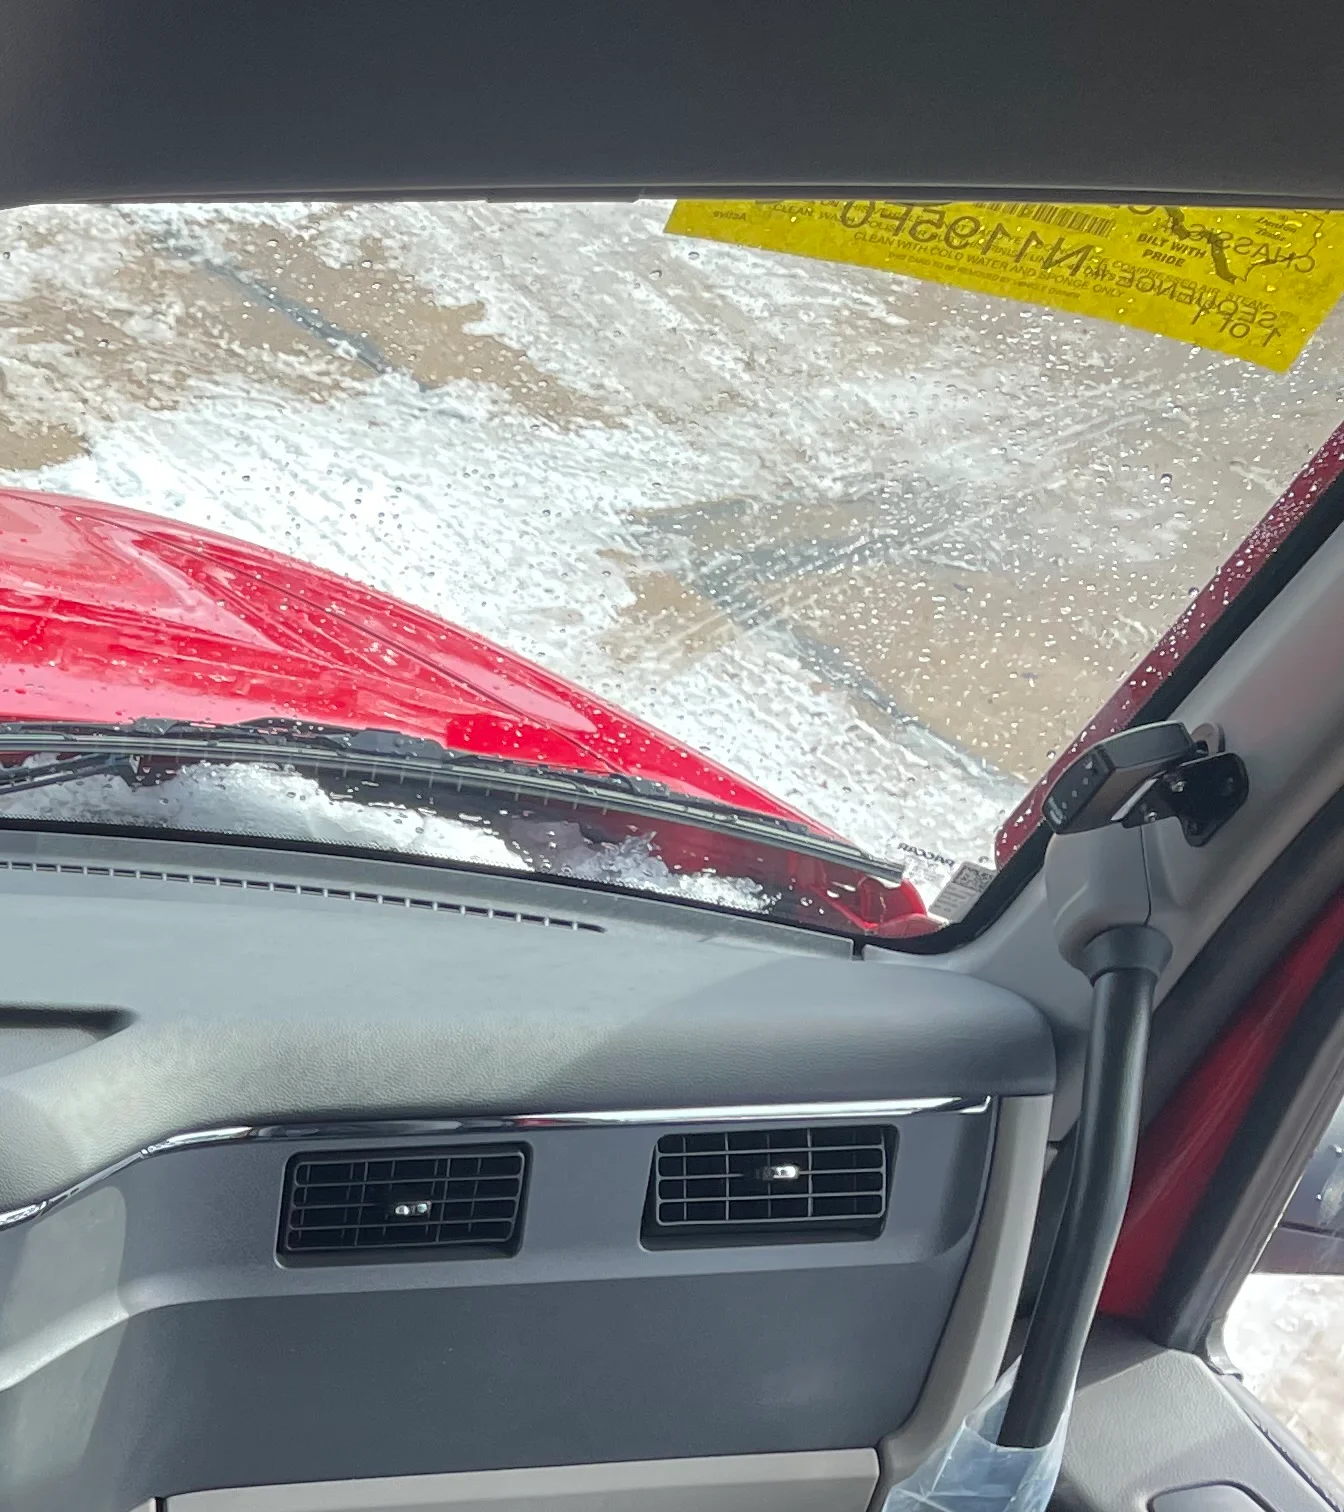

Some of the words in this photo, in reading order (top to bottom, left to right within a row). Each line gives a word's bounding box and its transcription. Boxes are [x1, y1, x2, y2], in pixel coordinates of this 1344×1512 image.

[1142, 248, 1185, 267] PRIDE
[1170, 241, 1208, 259] WITH
[853, 230, 893, 247] CLEAN
[896, 239, 927, 254] WITH
[929, 245, 962, 261] COLD
[967, 253, 1008, 271] WATER
[1007, 263, 1035, 278] AND
[1039, 270, 1088, 290] SPONGE
[1091, 283, 1124, 299] ONLY
